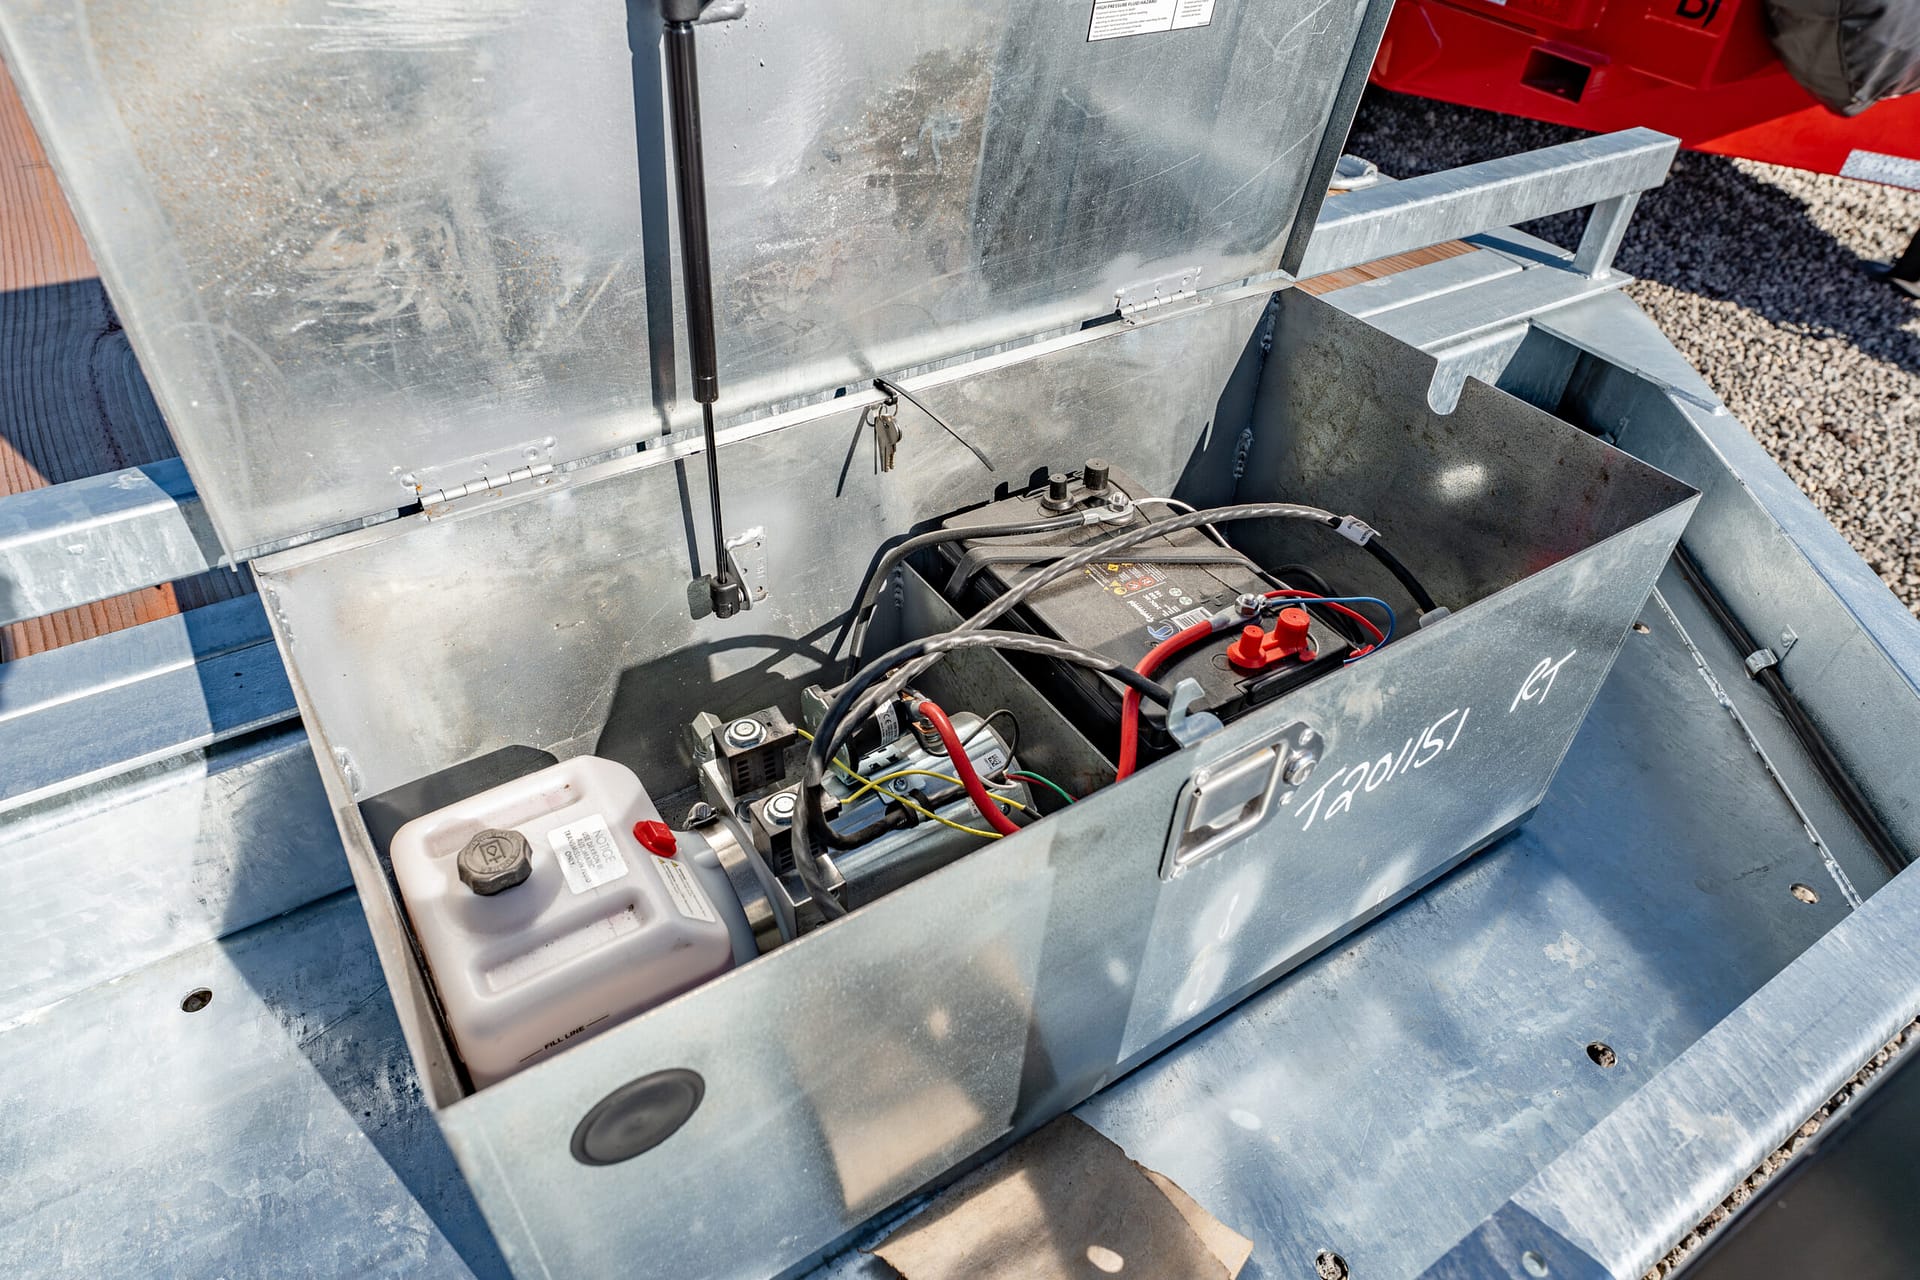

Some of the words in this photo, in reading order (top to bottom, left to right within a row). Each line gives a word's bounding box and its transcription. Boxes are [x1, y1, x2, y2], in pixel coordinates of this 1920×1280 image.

[1293, 707, 1471, 832] T201151
[1509, 648, 1577, 713] RT
[564, 850, 575, 867] ONLY
[593, 829, 616, 864] NOTICE
[544, 1038, 564, 1050] FILL
[565, 1026, 585, 1039] LINE
